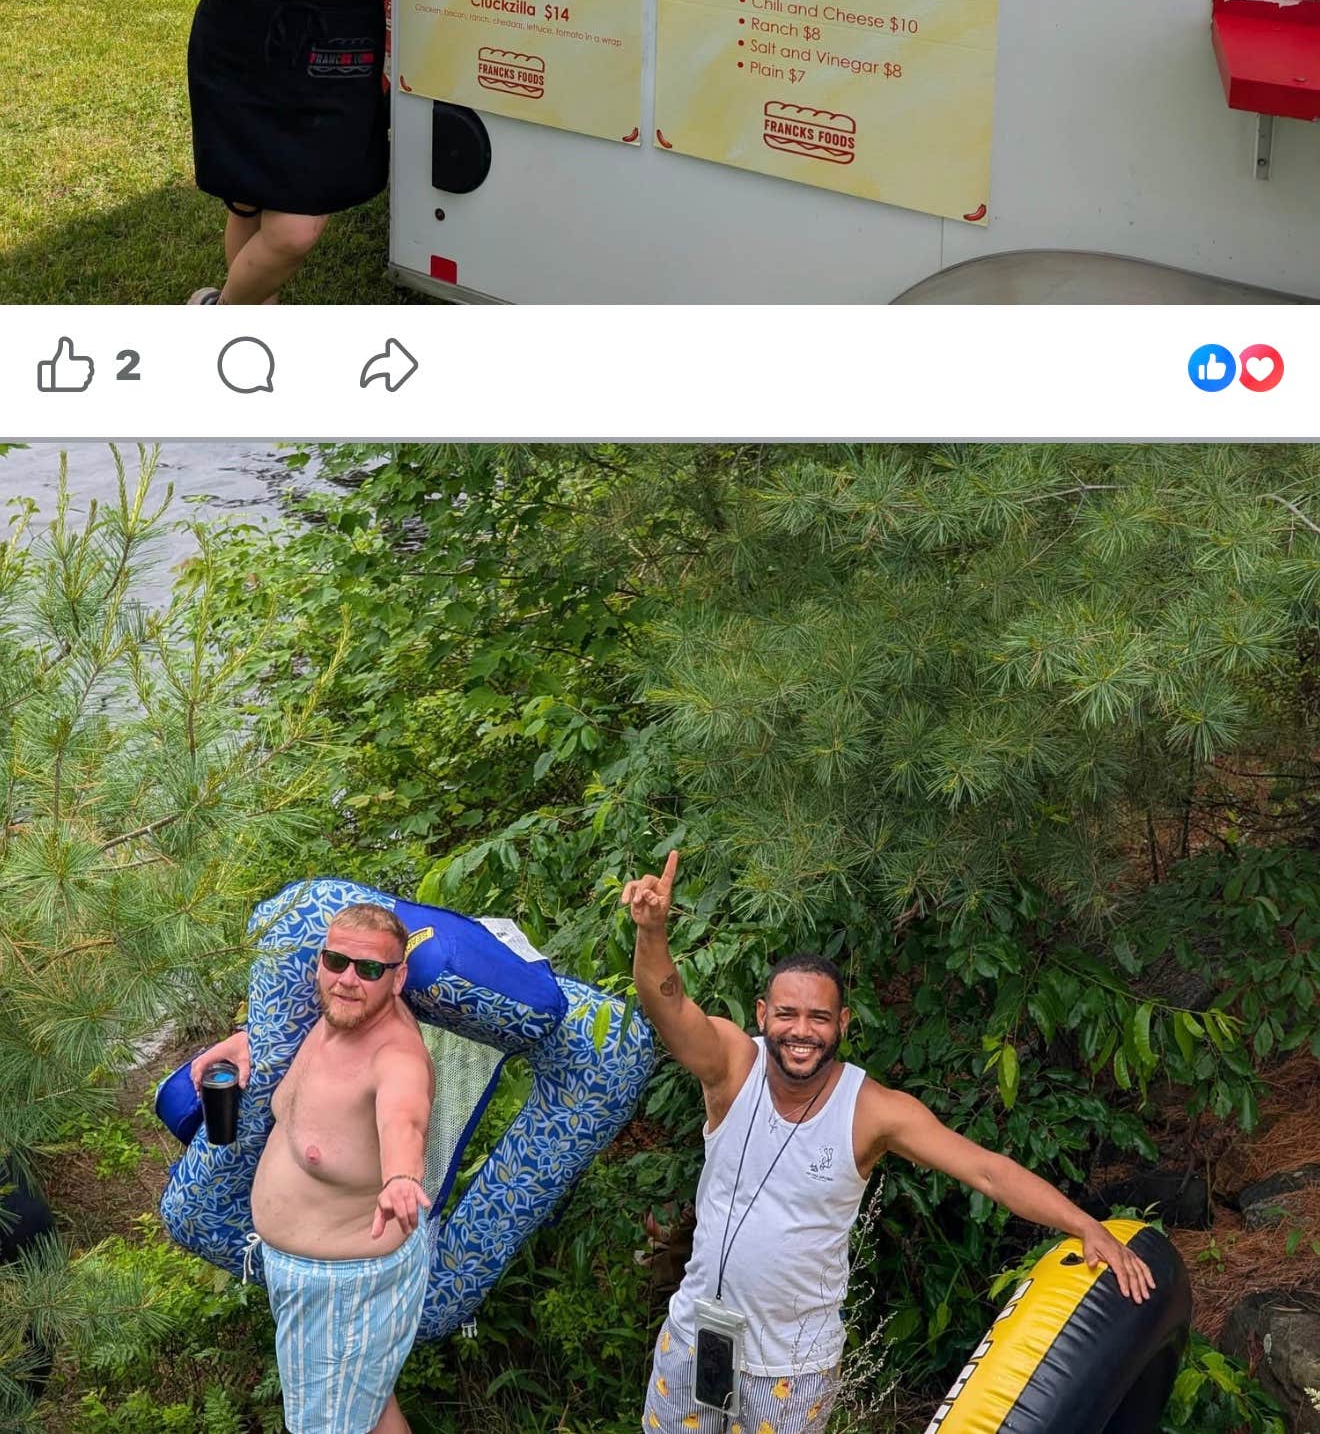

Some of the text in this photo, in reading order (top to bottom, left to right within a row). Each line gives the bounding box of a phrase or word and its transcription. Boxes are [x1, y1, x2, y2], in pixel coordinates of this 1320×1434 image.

[544, 4, 570, 22] $14
[787, 4, 818, 18] and
[823, 6, 885, 29] Cheese
[889, 16, 919, 34] $10
[751, 16, 821, 42] Ranch $8
[750, 38, 902, 79] Salt and Vinegar $8
[478, 63, 545, 86] FRANCKS FOODS
[749, 61, 806, 85] Plain $7
[764, 118, 855, 149] FRANCKS FOODS
[116, 349, 141, 381] 2
